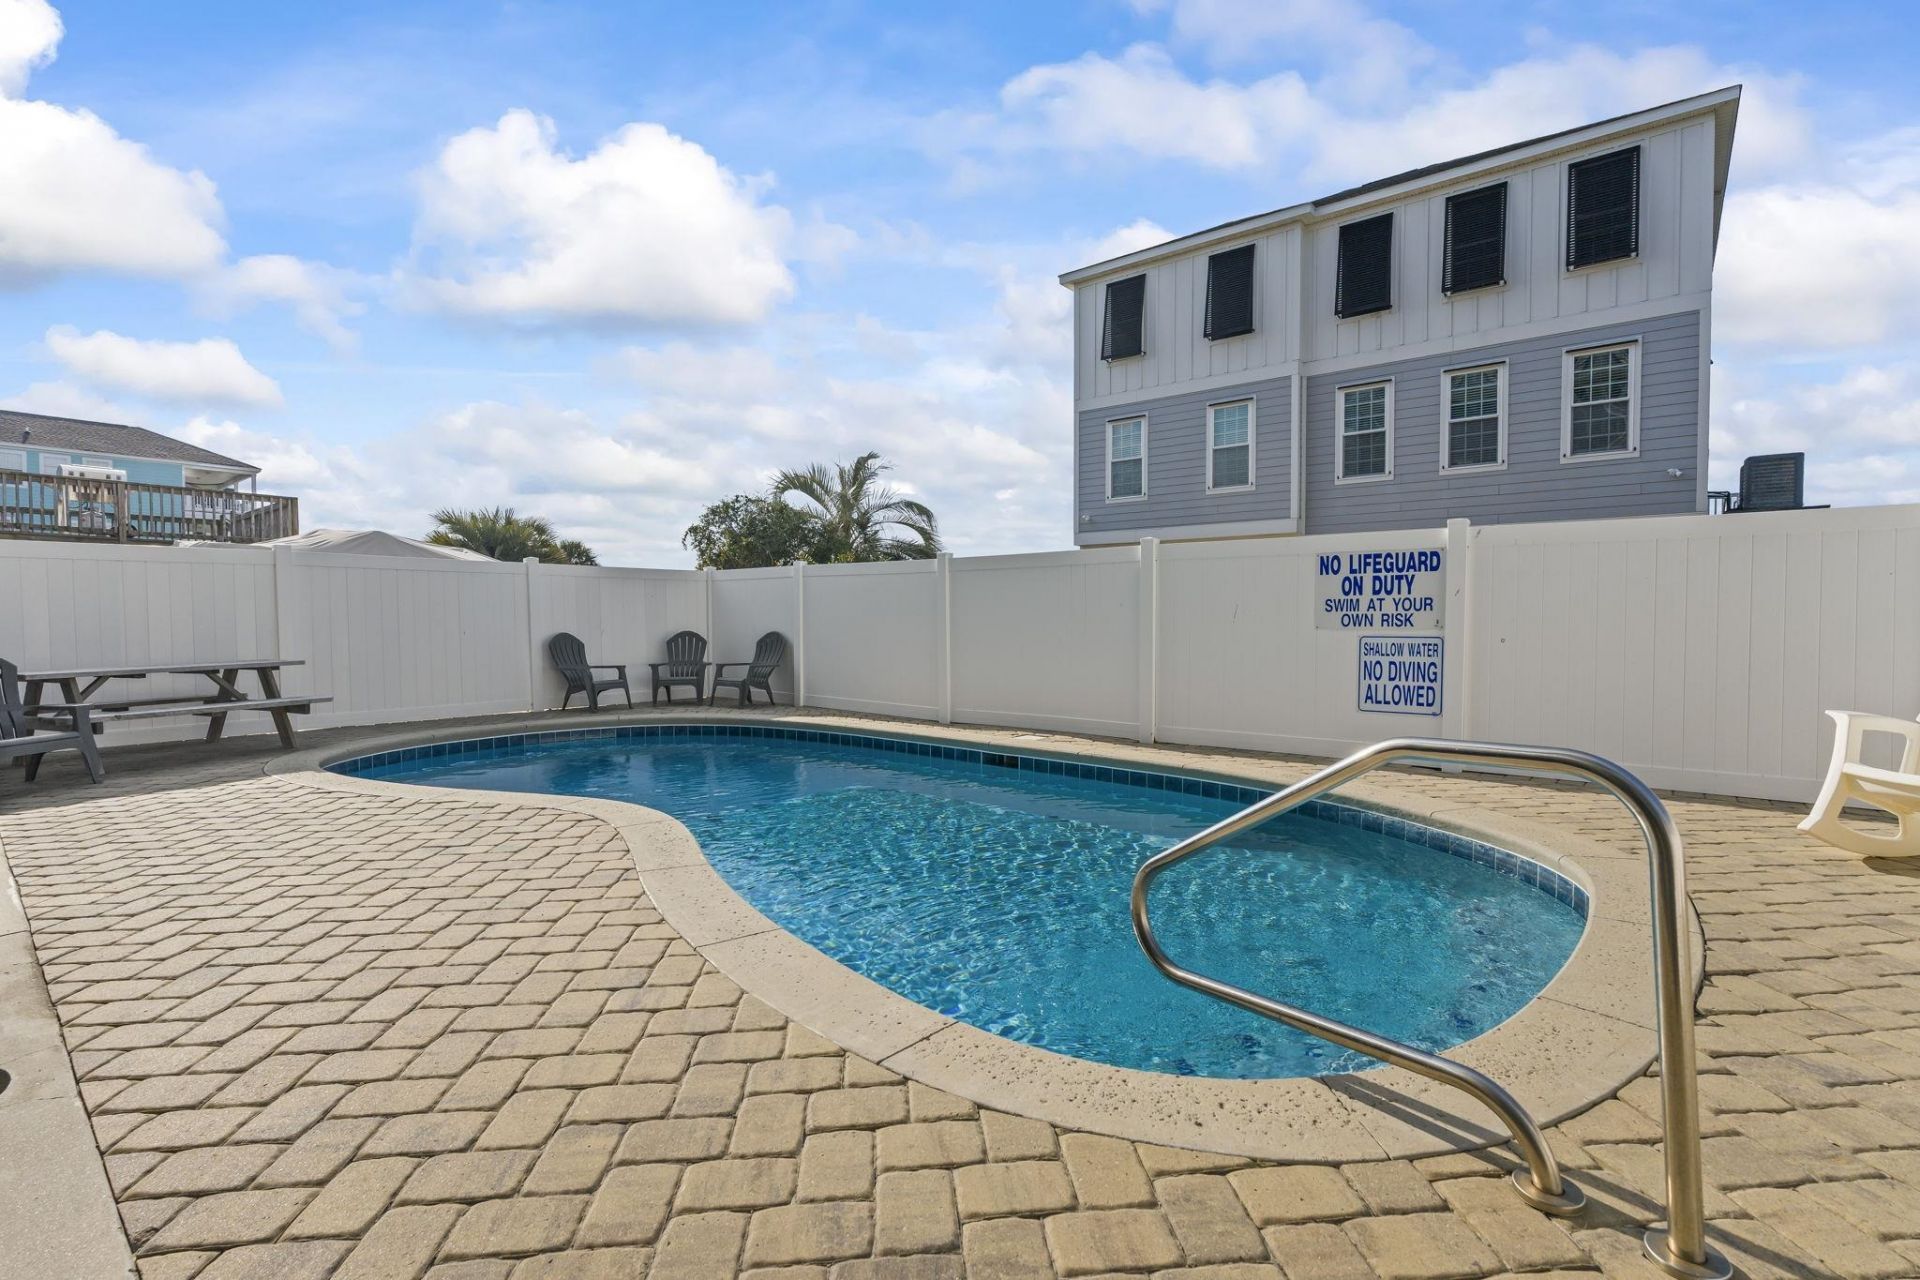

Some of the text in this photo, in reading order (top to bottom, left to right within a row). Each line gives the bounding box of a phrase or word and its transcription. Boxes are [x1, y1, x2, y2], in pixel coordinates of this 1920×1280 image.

[1319, 551, 1441, 575] NO LIFEGUARD
[1341, 574, 1415, 596] ON DUTY
[1325, 597, 1433, 612] SWIM AT YOUR
[1341, 613, 1414, 627] OWN RISK
[1363, 642, 1439, 657] SHALLOW WATER
[1363, 660, 1438, 683] NO DIVING
[1364, 683, 1436, 707] ALLOWED
